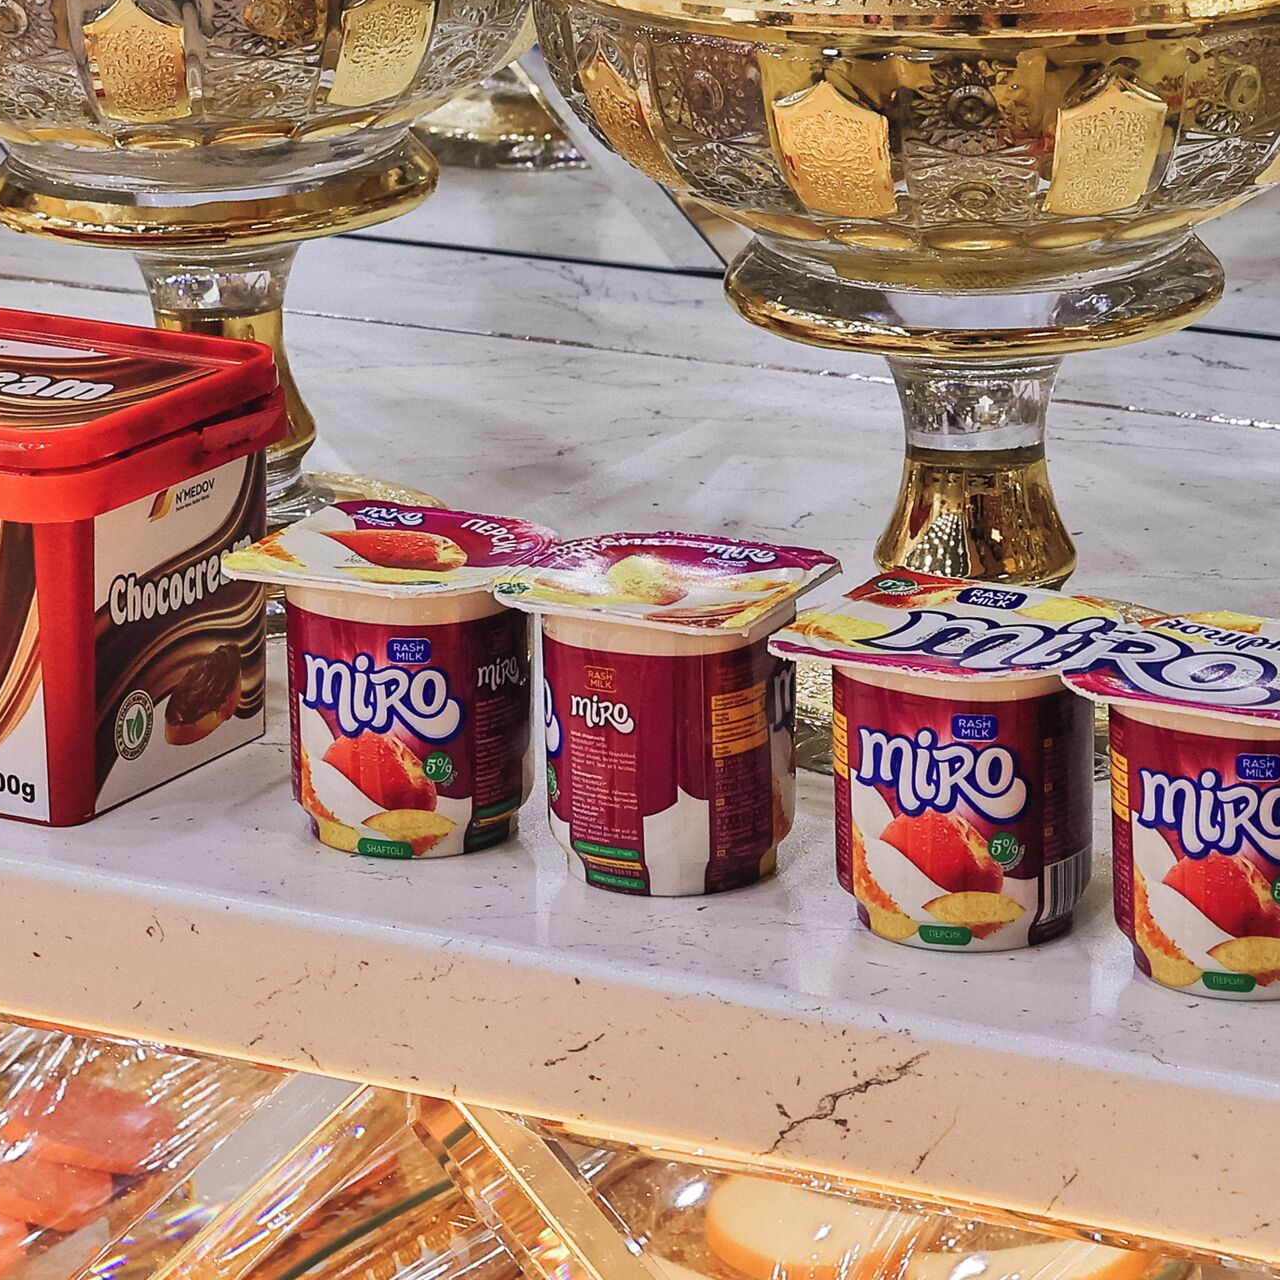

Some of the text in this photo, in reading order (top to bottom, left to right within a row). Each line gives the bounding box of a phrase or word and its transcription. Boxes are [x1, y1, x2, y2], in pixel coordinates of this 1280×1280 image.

[461, 518, 519, 556] ПЕРСИК
[109, 534, 252, 626] Chococre
[970, 589, 1019, 602] RASH
[968, 596, 1012, 609] MILK
[393, 641, 425, 652] RASH
[395, 652, 423, 662] MILK
[587, 668, 614, 680] RASH
[588, 679, 613, 690] MILK
[958, 716, 993, 730] RASH
[960, 727, 991, 740] MILK
[425, 757, 453, 776] 5%
[1242, 757, 1277, 769] RASH
[1245, 768, 1275, 780] MILK
[365, 843, 404, 856] SHAFTOLI
[990, 837, 1019, 857] 5%
[928, 928, 963, 943] ПЕРСИК
